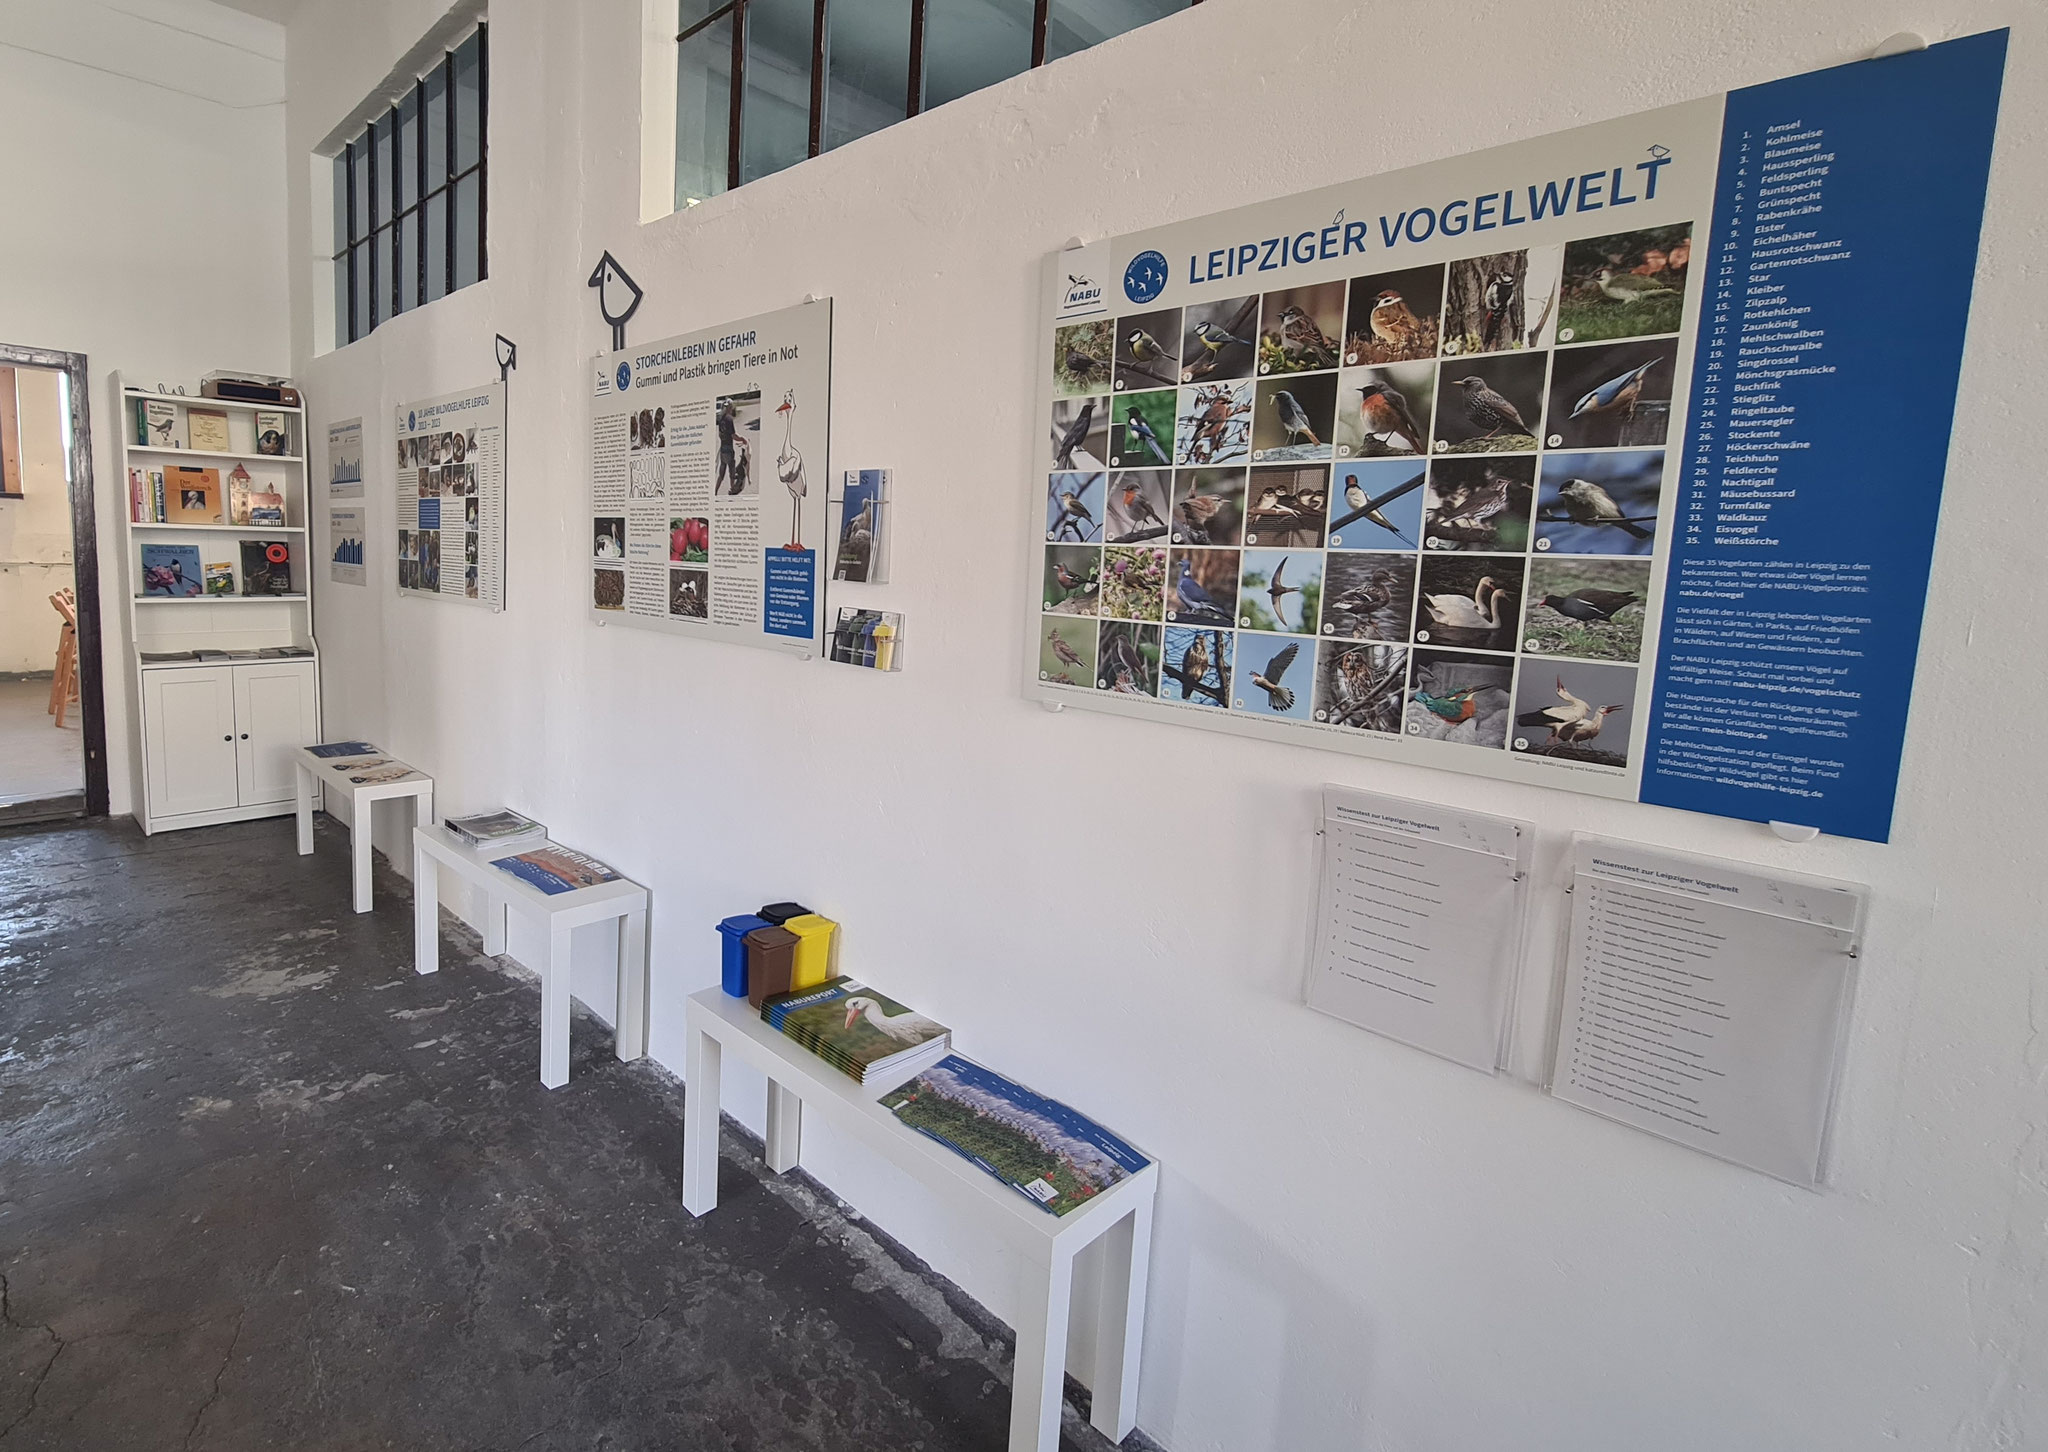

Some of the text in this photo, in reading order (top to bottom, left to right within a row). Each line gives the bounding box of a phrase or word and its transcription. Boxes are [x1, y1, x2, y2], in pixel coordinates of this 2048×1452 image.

[1742, 119, 1801, 140] 1. Amsel
[1740, 129, 1824, 152] 2. Kohlmeise
[1739, 142, 1822, 165] 3. Blaumeise
[1737, 152, 1835, 176] 4. Haussperling
[1736, 166, 1829, 189] 5. Feldsperling
[1734, 179, 1823, 201] 6. Buntspecht
[1734, 191, 1822, 213] 7. Grünspecht
[1189, 157, 1672, 285] LEIPZIGER VOGELWELT
[1731, 205, 1823, 226] 8. Rabenkrähe
[1730, 223, 1786, 238] 9. Elster
[1723, 231, 1817, 251] 10. Eichelhäher
[1721, 239, 1842, 263] 11. Hausrotschwanz
[1127, 252, 1165, 274] WILDVOGELHILFE
[1719, 251, 1851, 275] 12. Gartenrotschwanz
[1718, 274, 1772, 287] 13. Star
[1069, 288, 1101, 302] NABU
[1134, 293, 1155, 302] LEIPZIG
[1716, 284, 1785, 299] 14. Kleiber
[1715, 295, 1788, 311] 15. Zilpzalp
[1713, 306, 1811, 323] 16. Rotkehlchen
[1713, 319, 1799, 335] 17. Zaunkönig
[1710, 329, 1825, 347] 18. Mehlschwalben
[635, 330, 757, 370] STORCHENLEBEN IN GEFAHR
[1709, 341, 1823, 359] 19. Rauchschwalbe
[635, 344, 798, 388] Gummi und Plastik bringen Tiere in Not
[1707, 355, 1799, 371] 20. Singdrossel
[1705, 365, 1836, 382] 21. Mönchsgrasmücke
[1703, 381, 1781, 394] 22. Buchfink
[1702, 394, 1776, 406] 23. Stieglitz
[1701, 405, 1796, 418] 24. Ringeltaube
[1699, 417, 1795, 429] 25. Mauersegler
[1698, 430, 1781, 441] 26. Stockente
[1697, 440, 1811, 453] 27. Höckerschwäne
[1695, 454, 1779, 465] 28. Teichhuhn
[1694, 466, 1778, 476] 29. Feldlerche
[1692, 477, 1775, 487] 30. Nachtigall
[1691, 489, 1796, 499] 31. Mäusebussard
[1689, 501, 1772, 511] 32. Turmfalke
[1688, 513, 1768, 522] 33. Waldkauz
[1686, 525, 1759, 535] 34. Eisvogel
[1685, 536, 1780, 546] 35. Weißstörche
[1682, 558, 1705, 566] Diese
[1717, 559, 1763, 568] Vogelarten
[1764, 560, 1794, 569] zählen
[1794, 561, 1805, 569] in
[1805, 562, 1838, 572] Leipzig
[1851, 562, 1871, 571] den
[1681, 568, 1740, 577] bekanntesten.
[1741, 570, 1758, 578] Wer
[1786, 572, 1808, 580] über
[1809, 573, 1835, 582] Vögel
[1836, 573, 1868, 582] lernen
[1680, 579, 1868, 593] möchte, findet hier die NABU-Vogelporträts:
[1679, 589, 1745, 600] nabu.de/voegel
[1676, 606, 1691, 614] Die
[1691, 607, 1720, 616] Vielfalt
[1720, 609, 1735, 617] der
[1745, 610, 1777, 620] Leipzig
[1777, 611, 1820, 621] lebenden
[1821, 614, 1872, 624] Vogelarten
[1732, 681, 1861, 699] nabu-leipzig.de/vogelschutz
[1701, 727, 1769, 740] mein-biotop.de
[1715, 777, 1824, 798] wildvogelhilfe-leipzig.de
[1336, 806, 1371, 818] Wissenstest
[1381, 814, 1409, 825] Leipziger
[1409, 820, 1441, 832] Vogelwelt
[1592, 858, 1640, 873] Wissenstest
[1641, 868, 1654, 876] zur
[1656, 871, 1695, 884] Leipziger
[1695, 879, 1740, 894] Vogelwelt
[781, 988, 838, 1008] NABUREPORT
